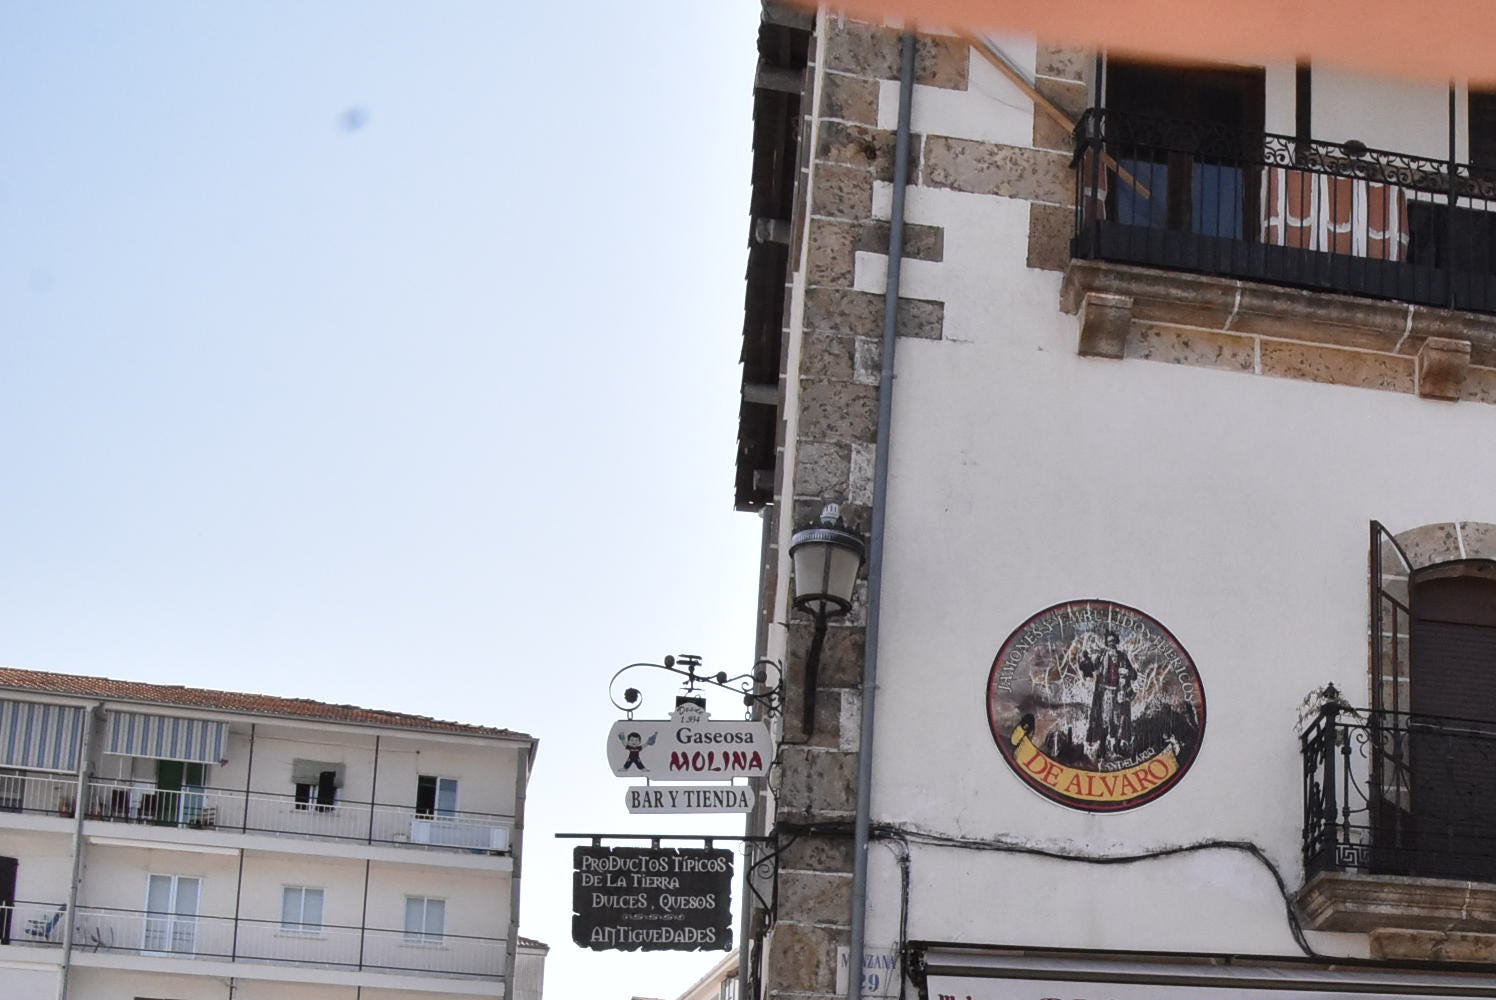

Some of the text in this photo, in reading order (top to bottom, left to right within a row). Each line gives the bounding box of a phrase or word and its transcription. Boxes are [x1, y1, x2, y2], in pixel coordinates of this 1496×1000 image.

[676, 727, 754, 744] Gaseosa
[669, 751, 763, 772] MOLINA
[1022, 751, 1170, 797] DE ALVARO
[631, 790, 749, 809] BAR Y TIENDA
[582, 855, 669, 873] PRODUCTOS
[582, 873, 680, 889] DE LA TIERRA
[659, 893, 716, 912] QUESOS
[590, 926, 716, 946] ANTIGUEDADES
